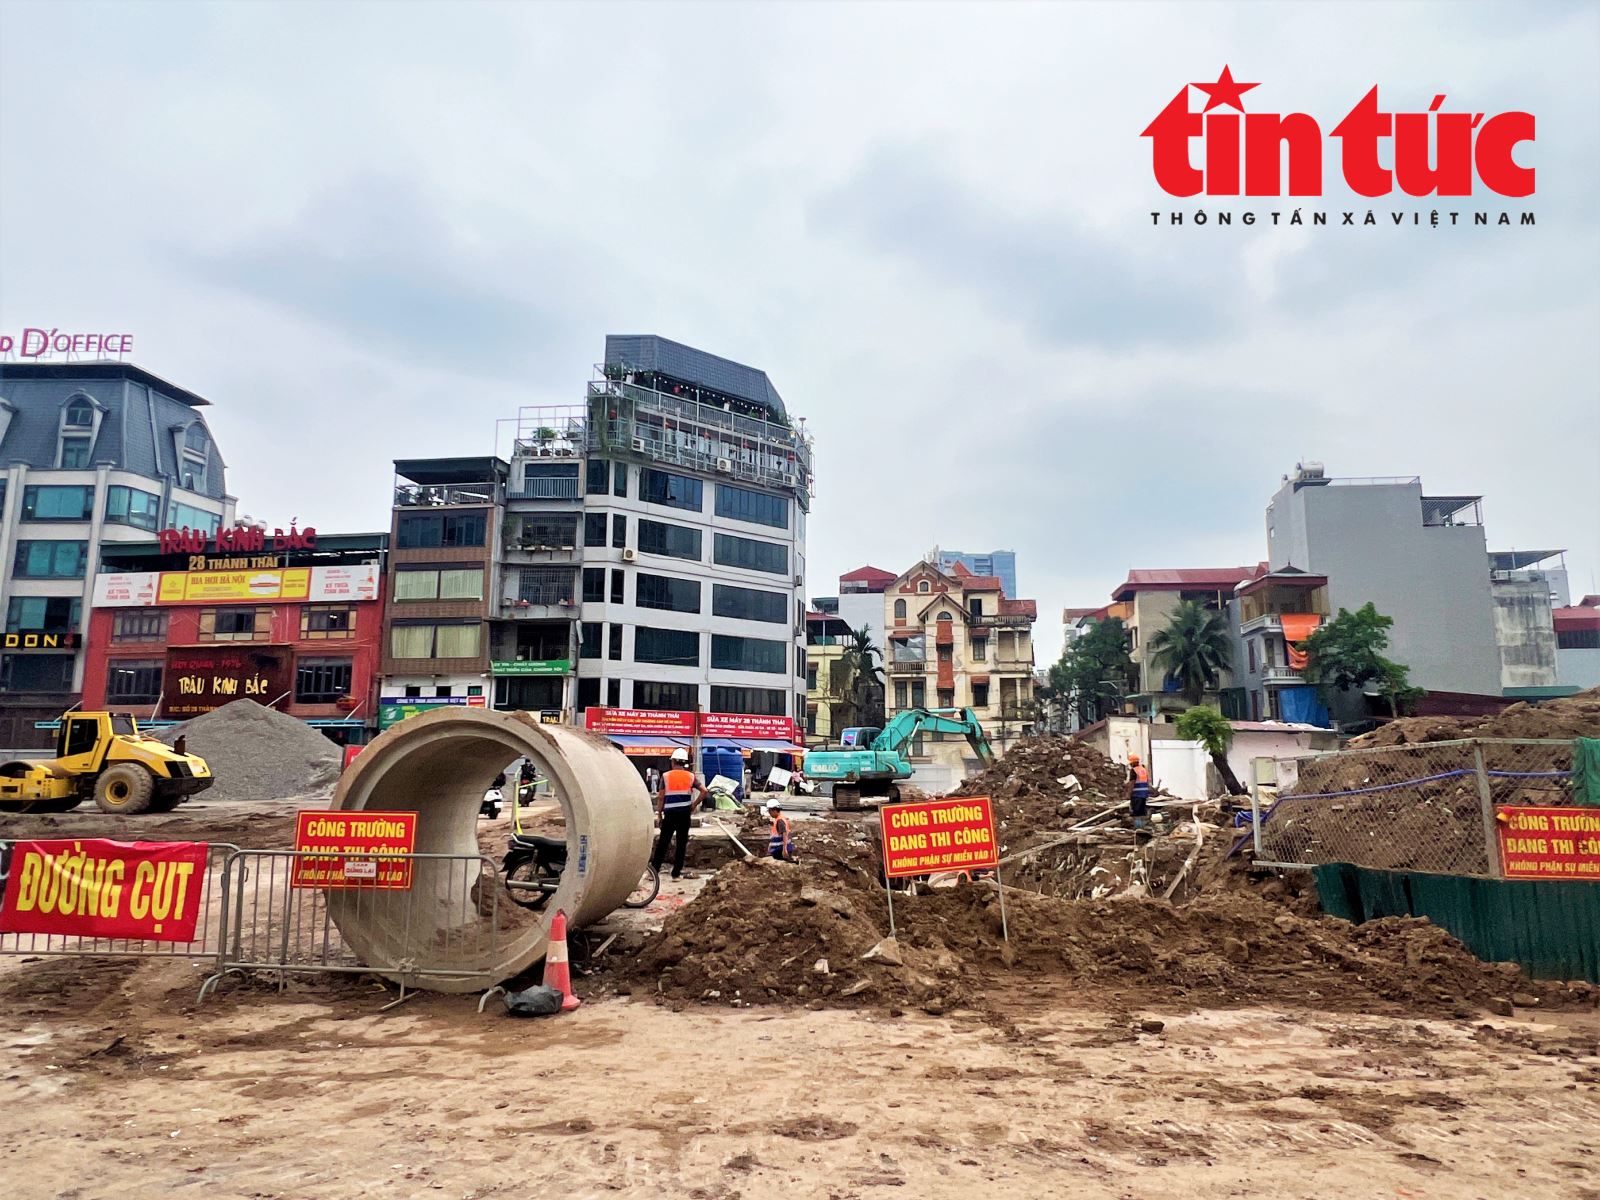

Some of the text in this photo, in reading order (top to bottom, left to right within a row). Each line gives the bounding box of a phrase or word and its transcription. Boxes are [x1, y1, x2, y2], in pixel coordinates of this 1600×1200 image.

[158, 516, 316, 554] TRÂU KINH BẮC
[188, 555, 206, 571] 28
[208, 554, 248, 570] THÀNH
[178, 672, 269, 695] TRÂU KINH BẮC
[891, 804, 983, 828] CÔNG TRƯỜNG
[1508, 812, 1549, 831] CÔNG
[307, 818, 406, 838] CÔNG TRƯỜNG
[889, 826, 991, 852] ĐANG THI CÔNG
[1551, 839, 1575, 855] THI
[16, 841, 195, 934] ĐƯỜNG CỤT
